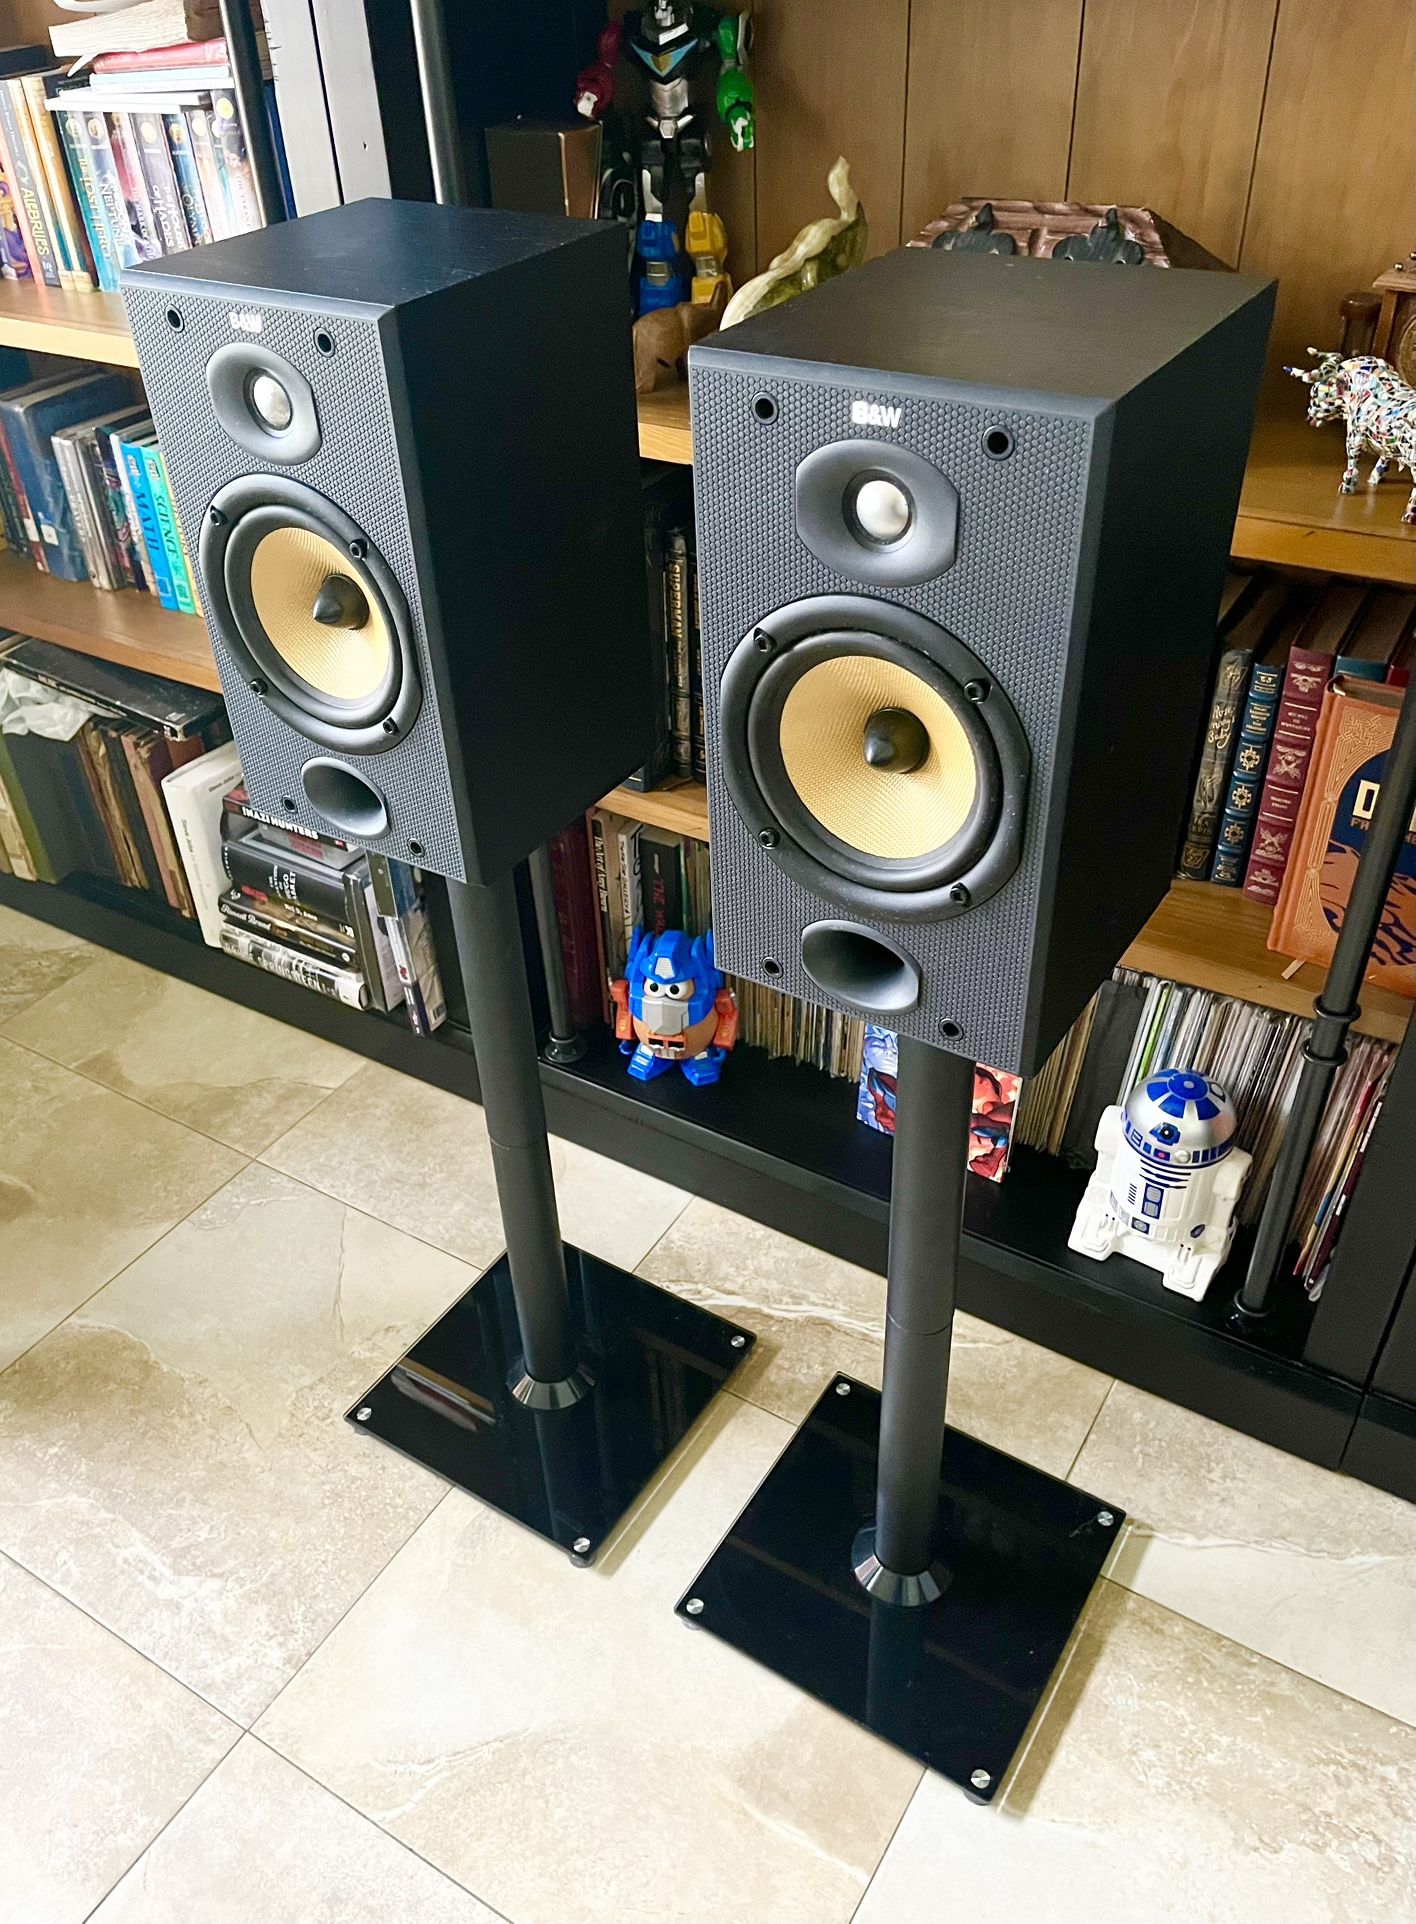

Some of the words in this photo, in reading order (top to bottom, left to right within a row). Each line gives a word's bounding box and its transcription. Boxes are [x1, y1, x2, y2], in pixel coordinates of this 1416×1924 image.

[98, 181, 126, 247] NEPTUNE
[153, 197, 176, 248] HADES
[165, 201, 188, 249] HOUSE
[228, 311, 264, 334] B&W
[852, 401, 902, 428] B&W
[134, 491, 159, 551] MATH
[154, 494, 180, 560] SCIENCE
[671, 563, 683, 639] SUPERMAN
[270, 816, 318, 840] HUNTERS
